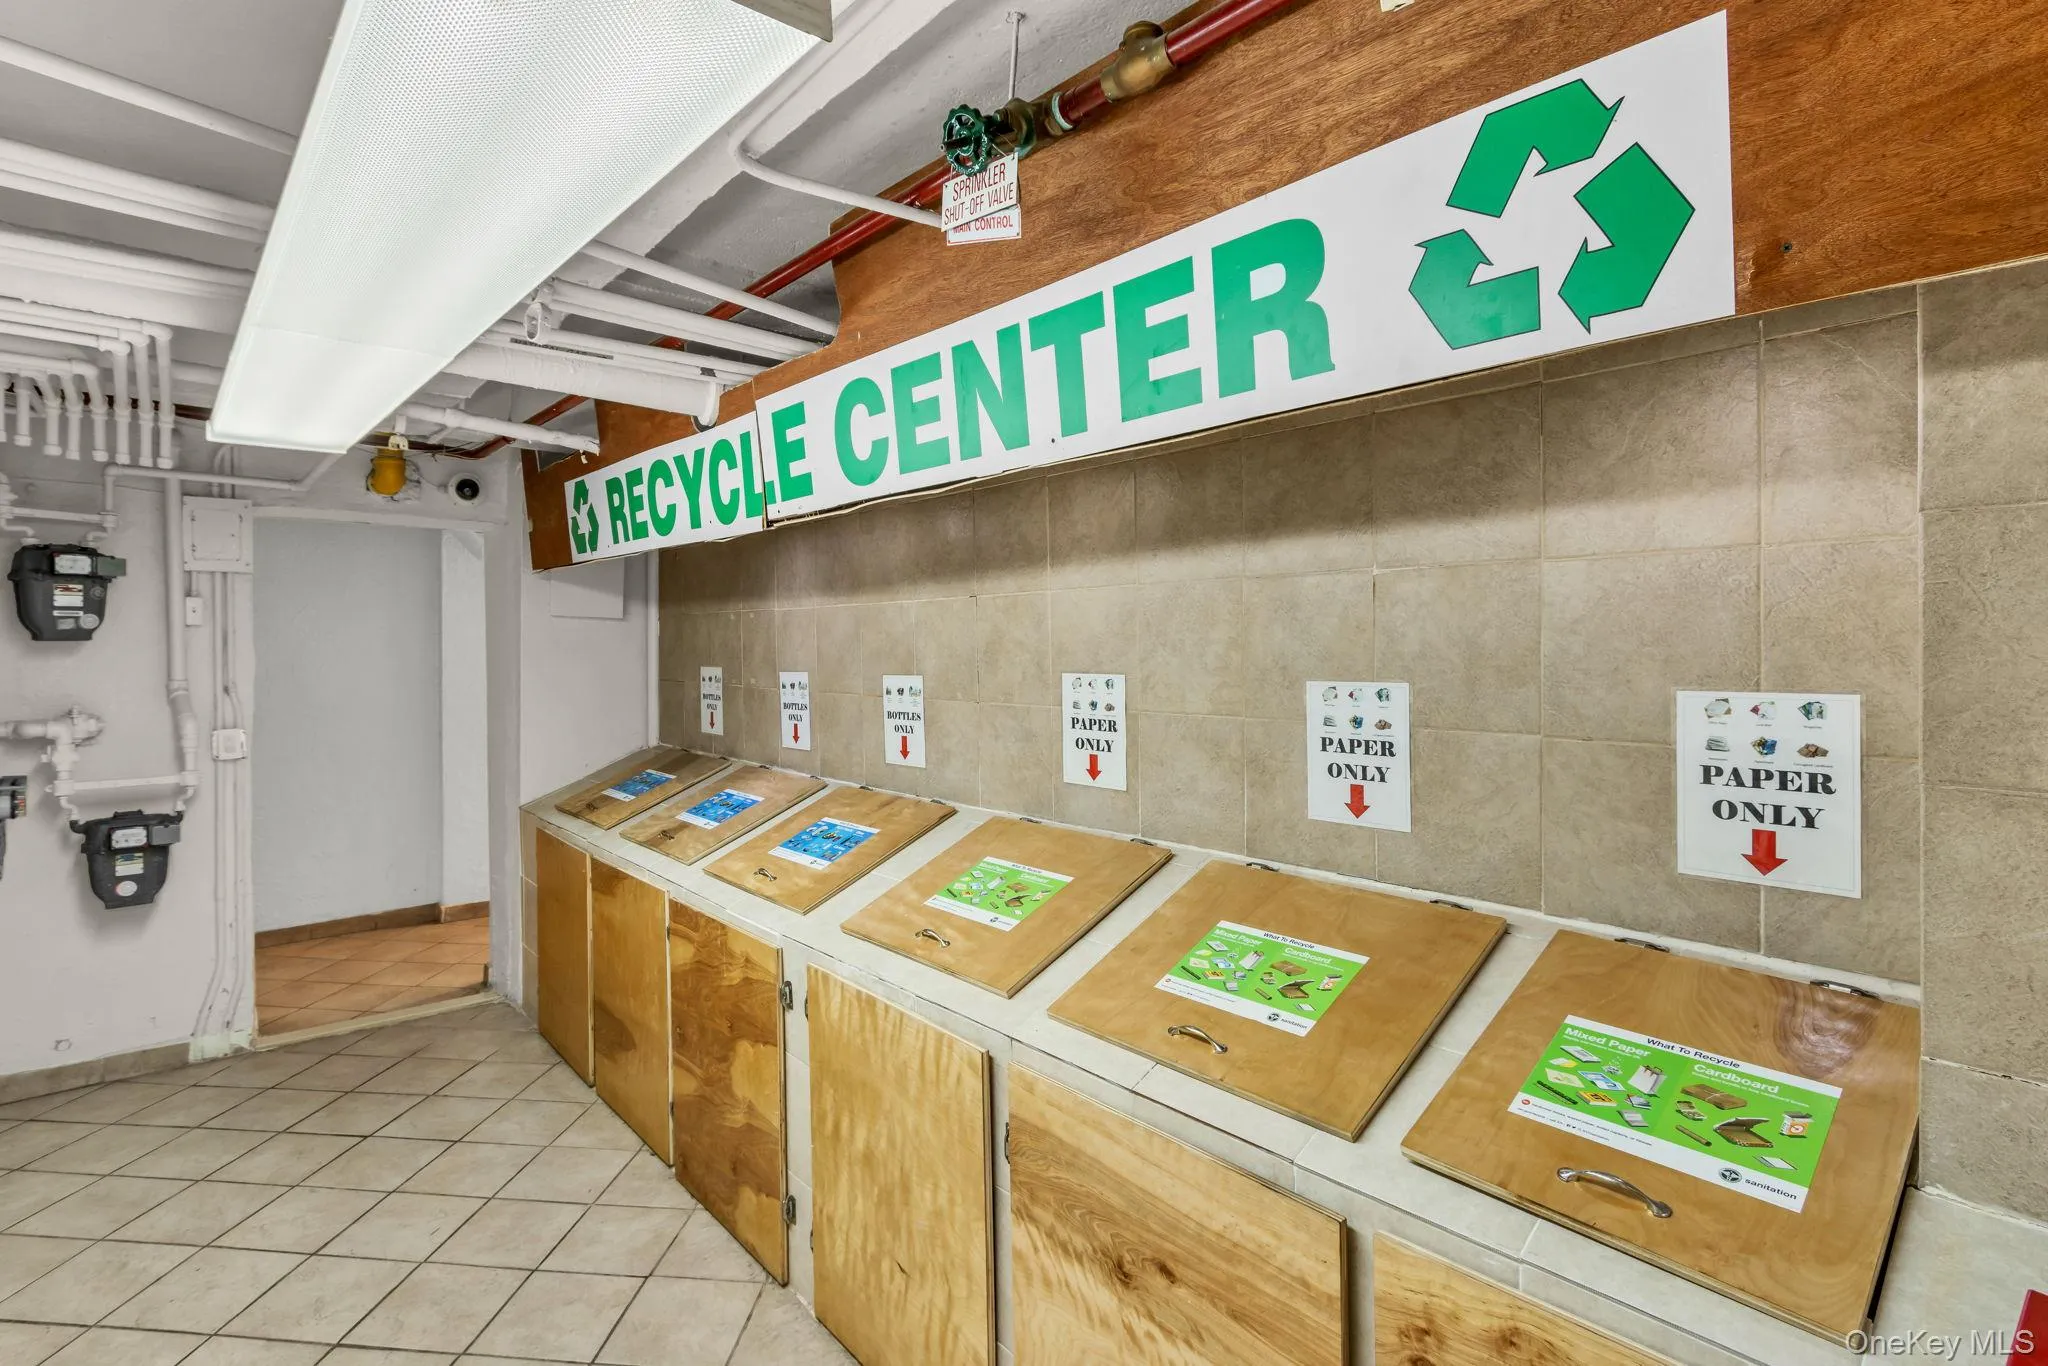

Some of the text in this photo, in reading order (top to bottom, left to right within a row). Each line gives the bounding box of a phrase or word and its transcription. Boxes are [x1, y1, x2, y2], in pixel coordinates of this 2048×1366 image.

[952, 162, 1006, 202] SPRINKLER
[944, 182, 1014, 225] SHUT-OFF VALVE
[975, 215, 1014, 231] CONTROL
[605, 217, 1337, 545] RECYCLE CENTER
[702, 693, 722, 701] BOTTLES
[706, 703, 718, 711] ONLY
[783, 702, 808, 711] BOTTLES
[788, 714, 804, 722] ONLY
[886, 710, 922, 721] BOTTLES
[1070, 716, 1118, 733] PAPER
[894, 725, 915, 734] ONLY
[1075, 736, 1114, 753] ONLY
[1320, 736, 1397, 758] PAPER
[1327, 762, 1391, 784] ONLY
[1699, 764, 1837, 795] PAPER
[1712, 799, 1826, 830] ONLY
[1263, 931, 1280, 942] What
[1289, 938, 1316, 950] Recycle
[1564, 1027, 1607, 1045] Mixed
[1608, 1039, 1651, 1057] Paper
[1647, 1037, 1675, 1051] What
[1678, 1046, 1691, 1055] To
[1693, 1052, 1740, 1069] Recycle
[1692, 1064, 1780, 1094] Cardboard
[1744, 1178, 1798, 1200] sanitation
